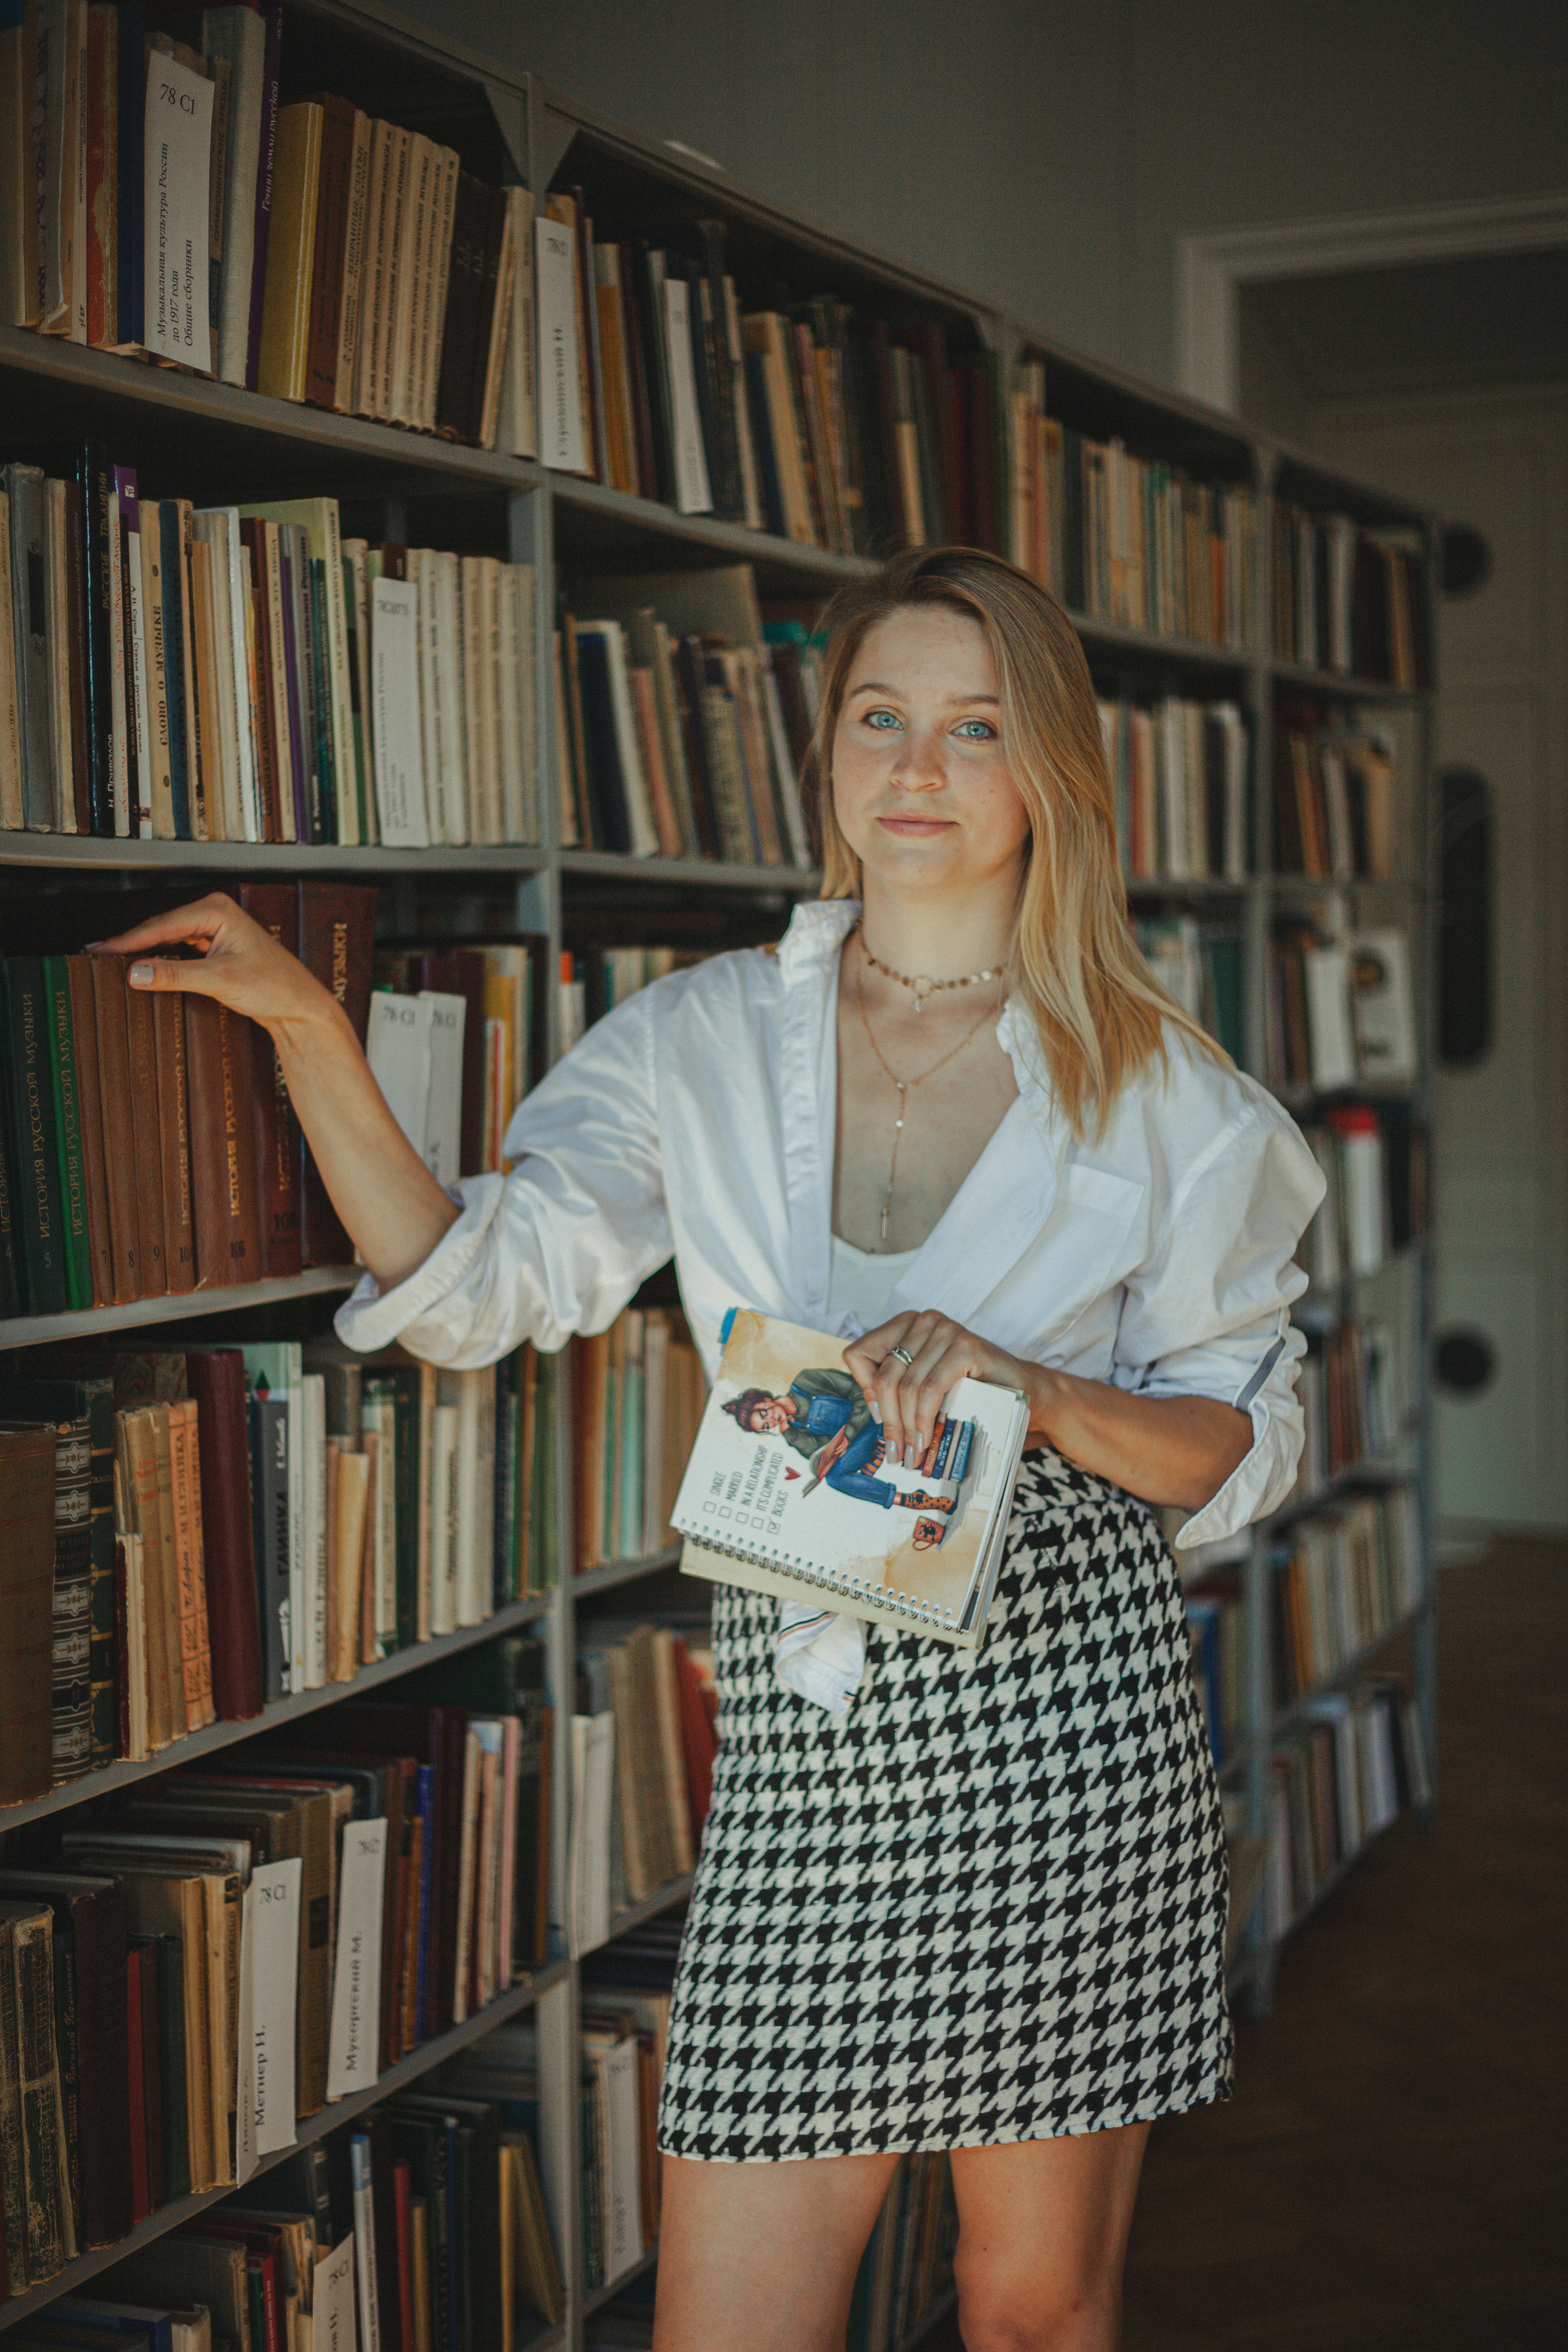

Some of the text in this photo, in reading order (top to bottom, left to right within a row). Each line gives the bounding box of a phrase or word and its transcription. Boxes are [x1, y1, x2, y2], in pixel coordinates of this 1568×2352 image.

[160, 84, 177, 105] 78
[213, 79, 228, 243] СИМФОНИЧЕСКИЕ ЭТЮДЫ
[262, 80, 279, 211] Гении земли русской
[157, 143, 168, 336] Музыкальная культура России
[170, 270, 179, 342] до 1917 года
[183, 239, 194, 346] Общие сборники
[98, 472, 111, 609] РУССКИЕ ТРАДИЦИИ
[153, 605, 168, 746] СЛОВО О МУЗЫКЕ
[333, 922, 348, 1003] МУЗЫКИ
[23, 993, 51, 1240] ИСТОРИЯ РУССКОЙ МУЗЫКИ
[56, 990, 83, 1237] ИСТОРИЯ РУССКОЙ МУЗЫКИ
[222, 1057, 236, 1134] РУССКОЙ
[227, 1140, 240, 1217] ИСТОРИЯ
[43, 1251, 52, 1268] 5
[127, 1250, 135, 1268] 8
[710, 1471, 727, 1496] SINGLE
[725, 1471, 744, 1501] MARRIED
[740, 1497, 752, 1507] IN
[745, 1444, 768, 1491] RELATIONSHIP
[755, 1452, 783, 1512] IT'S COMPLICATED
[771, 1489, 790, 1517] BOOKS
[275, 1491, 288, 1576] ГЛИНКА
[64, 1953, 77, 2084] Василий Калинников
[345, 1930, 363, 2071] Мусоргский М.
[254, 2025, 268, 2127] Метнер Н.
